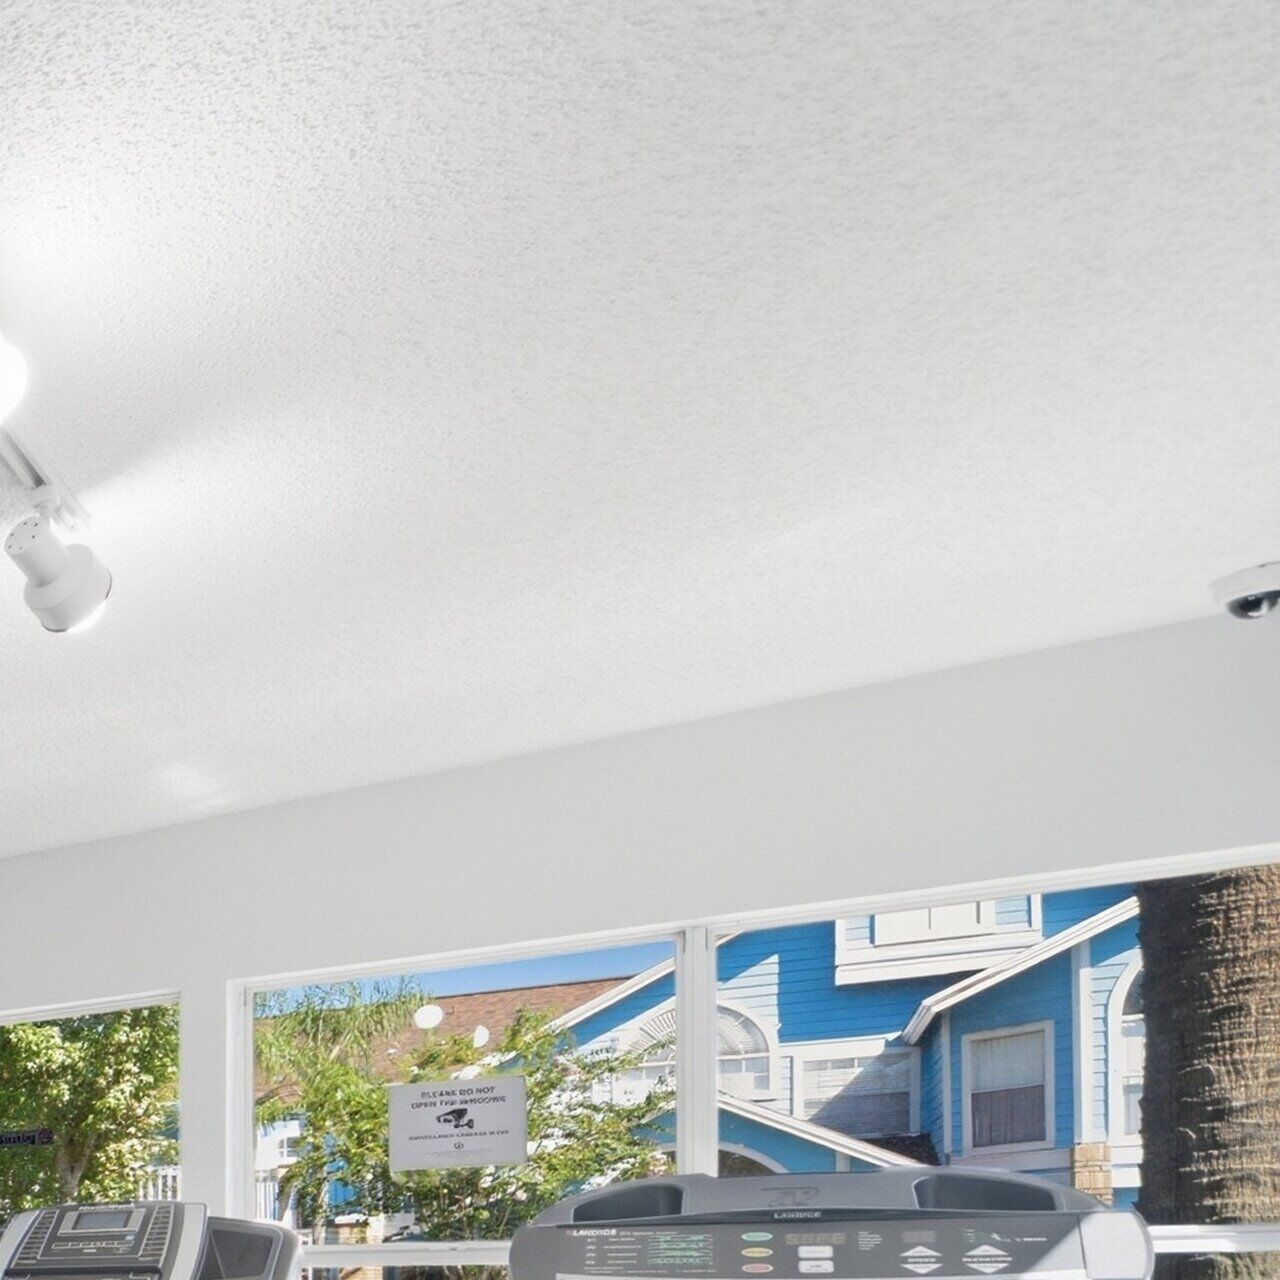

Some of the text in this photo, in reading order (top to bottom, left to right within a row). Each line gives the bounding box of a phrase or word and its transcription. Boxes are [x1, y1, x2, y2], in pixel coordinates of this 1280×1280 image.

[421, 1086, 496, 1099] PLEASE DO NOT
[411, 1101, 437, 1110] OPEN
